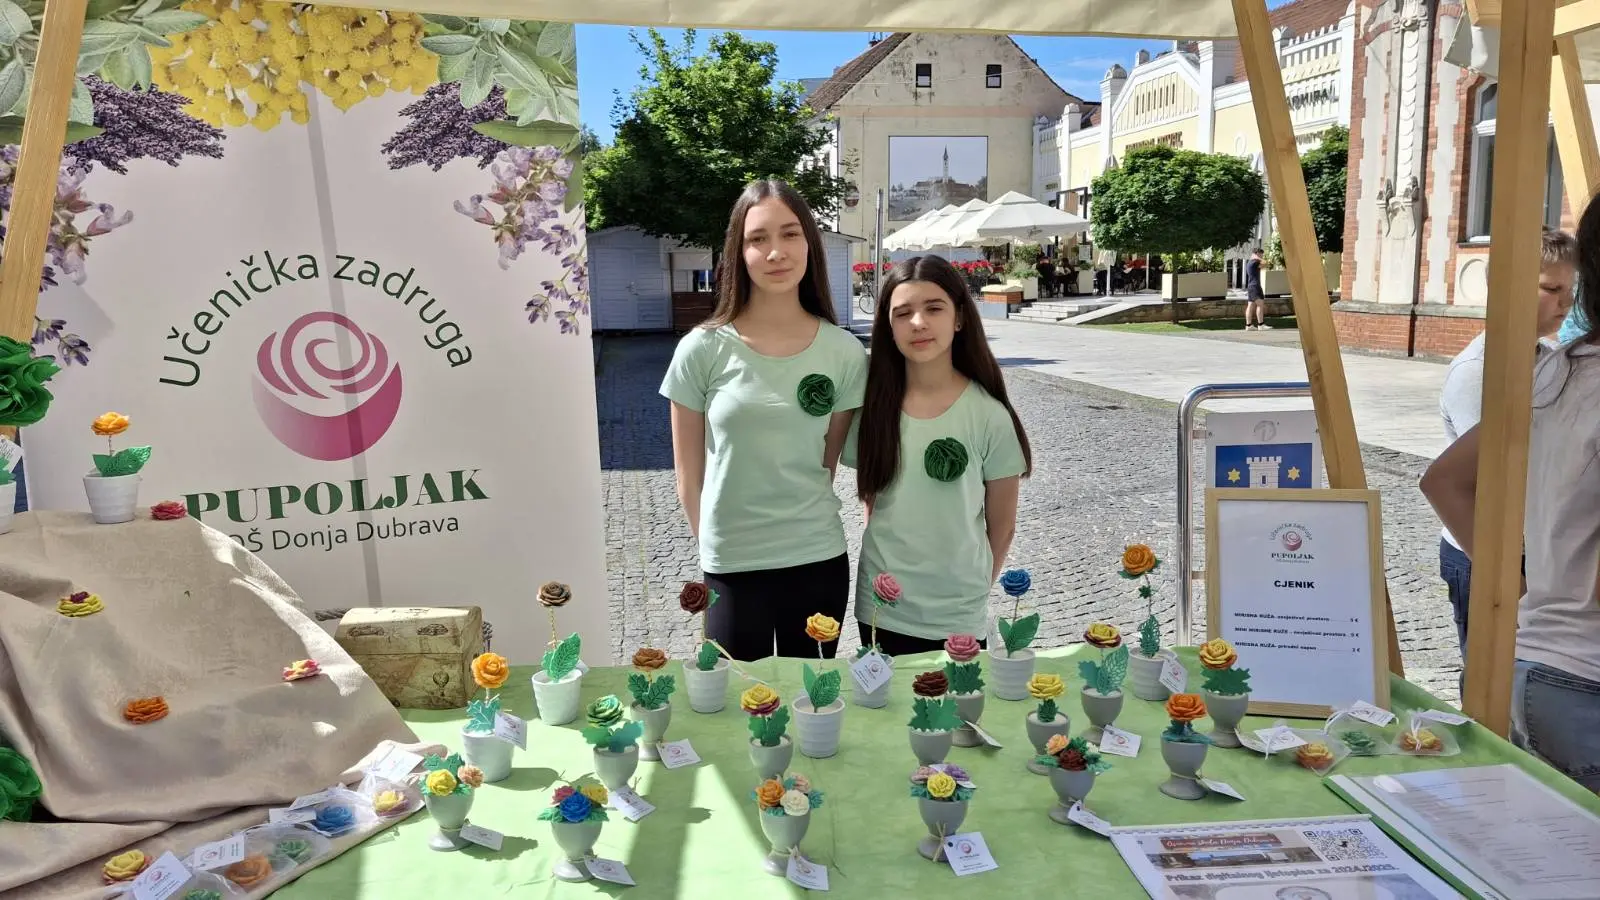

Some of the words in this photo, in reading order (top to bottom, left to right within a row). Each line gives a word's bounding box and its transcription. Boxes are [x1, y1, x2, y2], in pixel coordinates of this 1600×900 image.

[159, 250, 320, 387] Učenička
[333, 253, 473, 368] zadruga
[180, 468, 491, 523] PUPOLJAK
[272, 527, 348, 552] Donja
[356, 516, 460, 542] Dubrava
[1274, 580, 1315, 589] CJENIK
[1165, 873, 1203, 882] Prikaz
[1205, 871, 1264, 880] digitalnog
